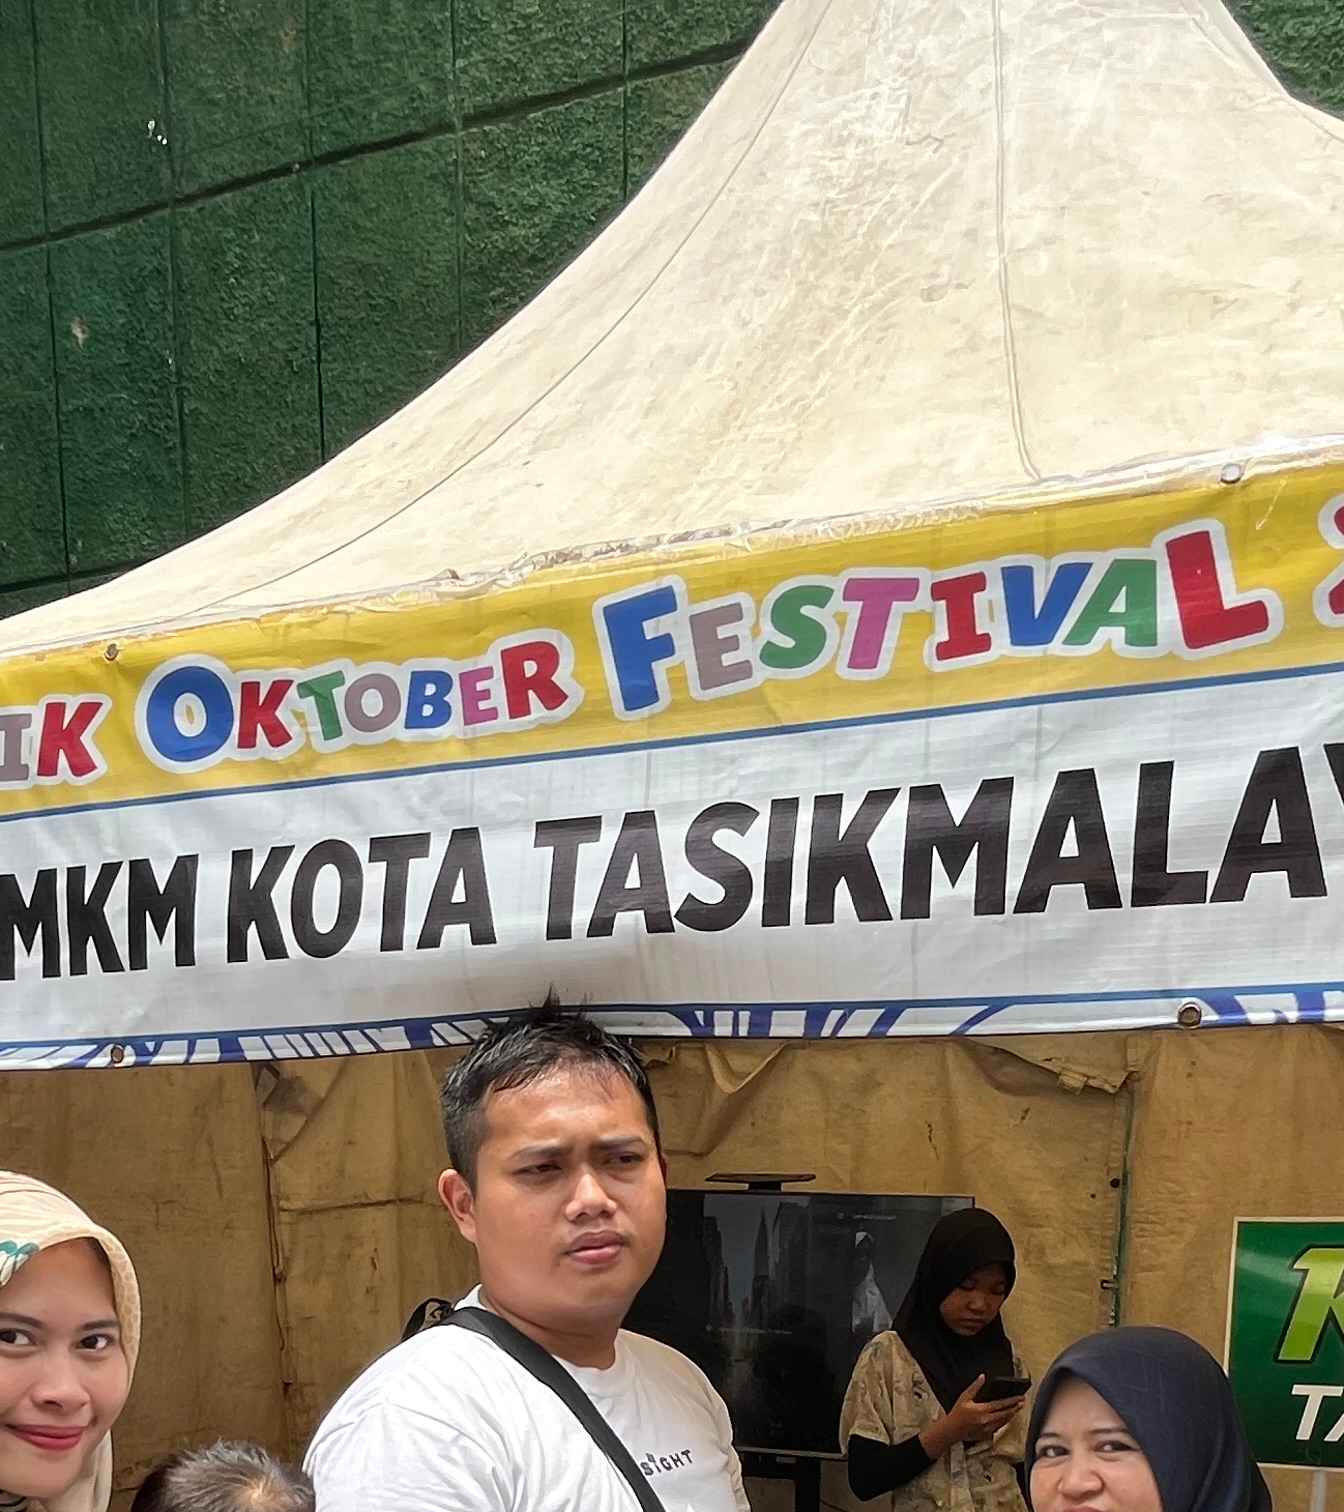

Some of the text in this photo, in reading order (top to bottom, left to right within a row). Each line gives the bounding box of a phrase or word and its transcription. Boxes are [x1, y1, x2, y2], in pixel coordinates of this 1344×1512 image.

[145, 639, 571, 763] OKTOBER
[603, 529, 1270, 712] FESTIVAL
[226, 826, 498, 964] KOTA
